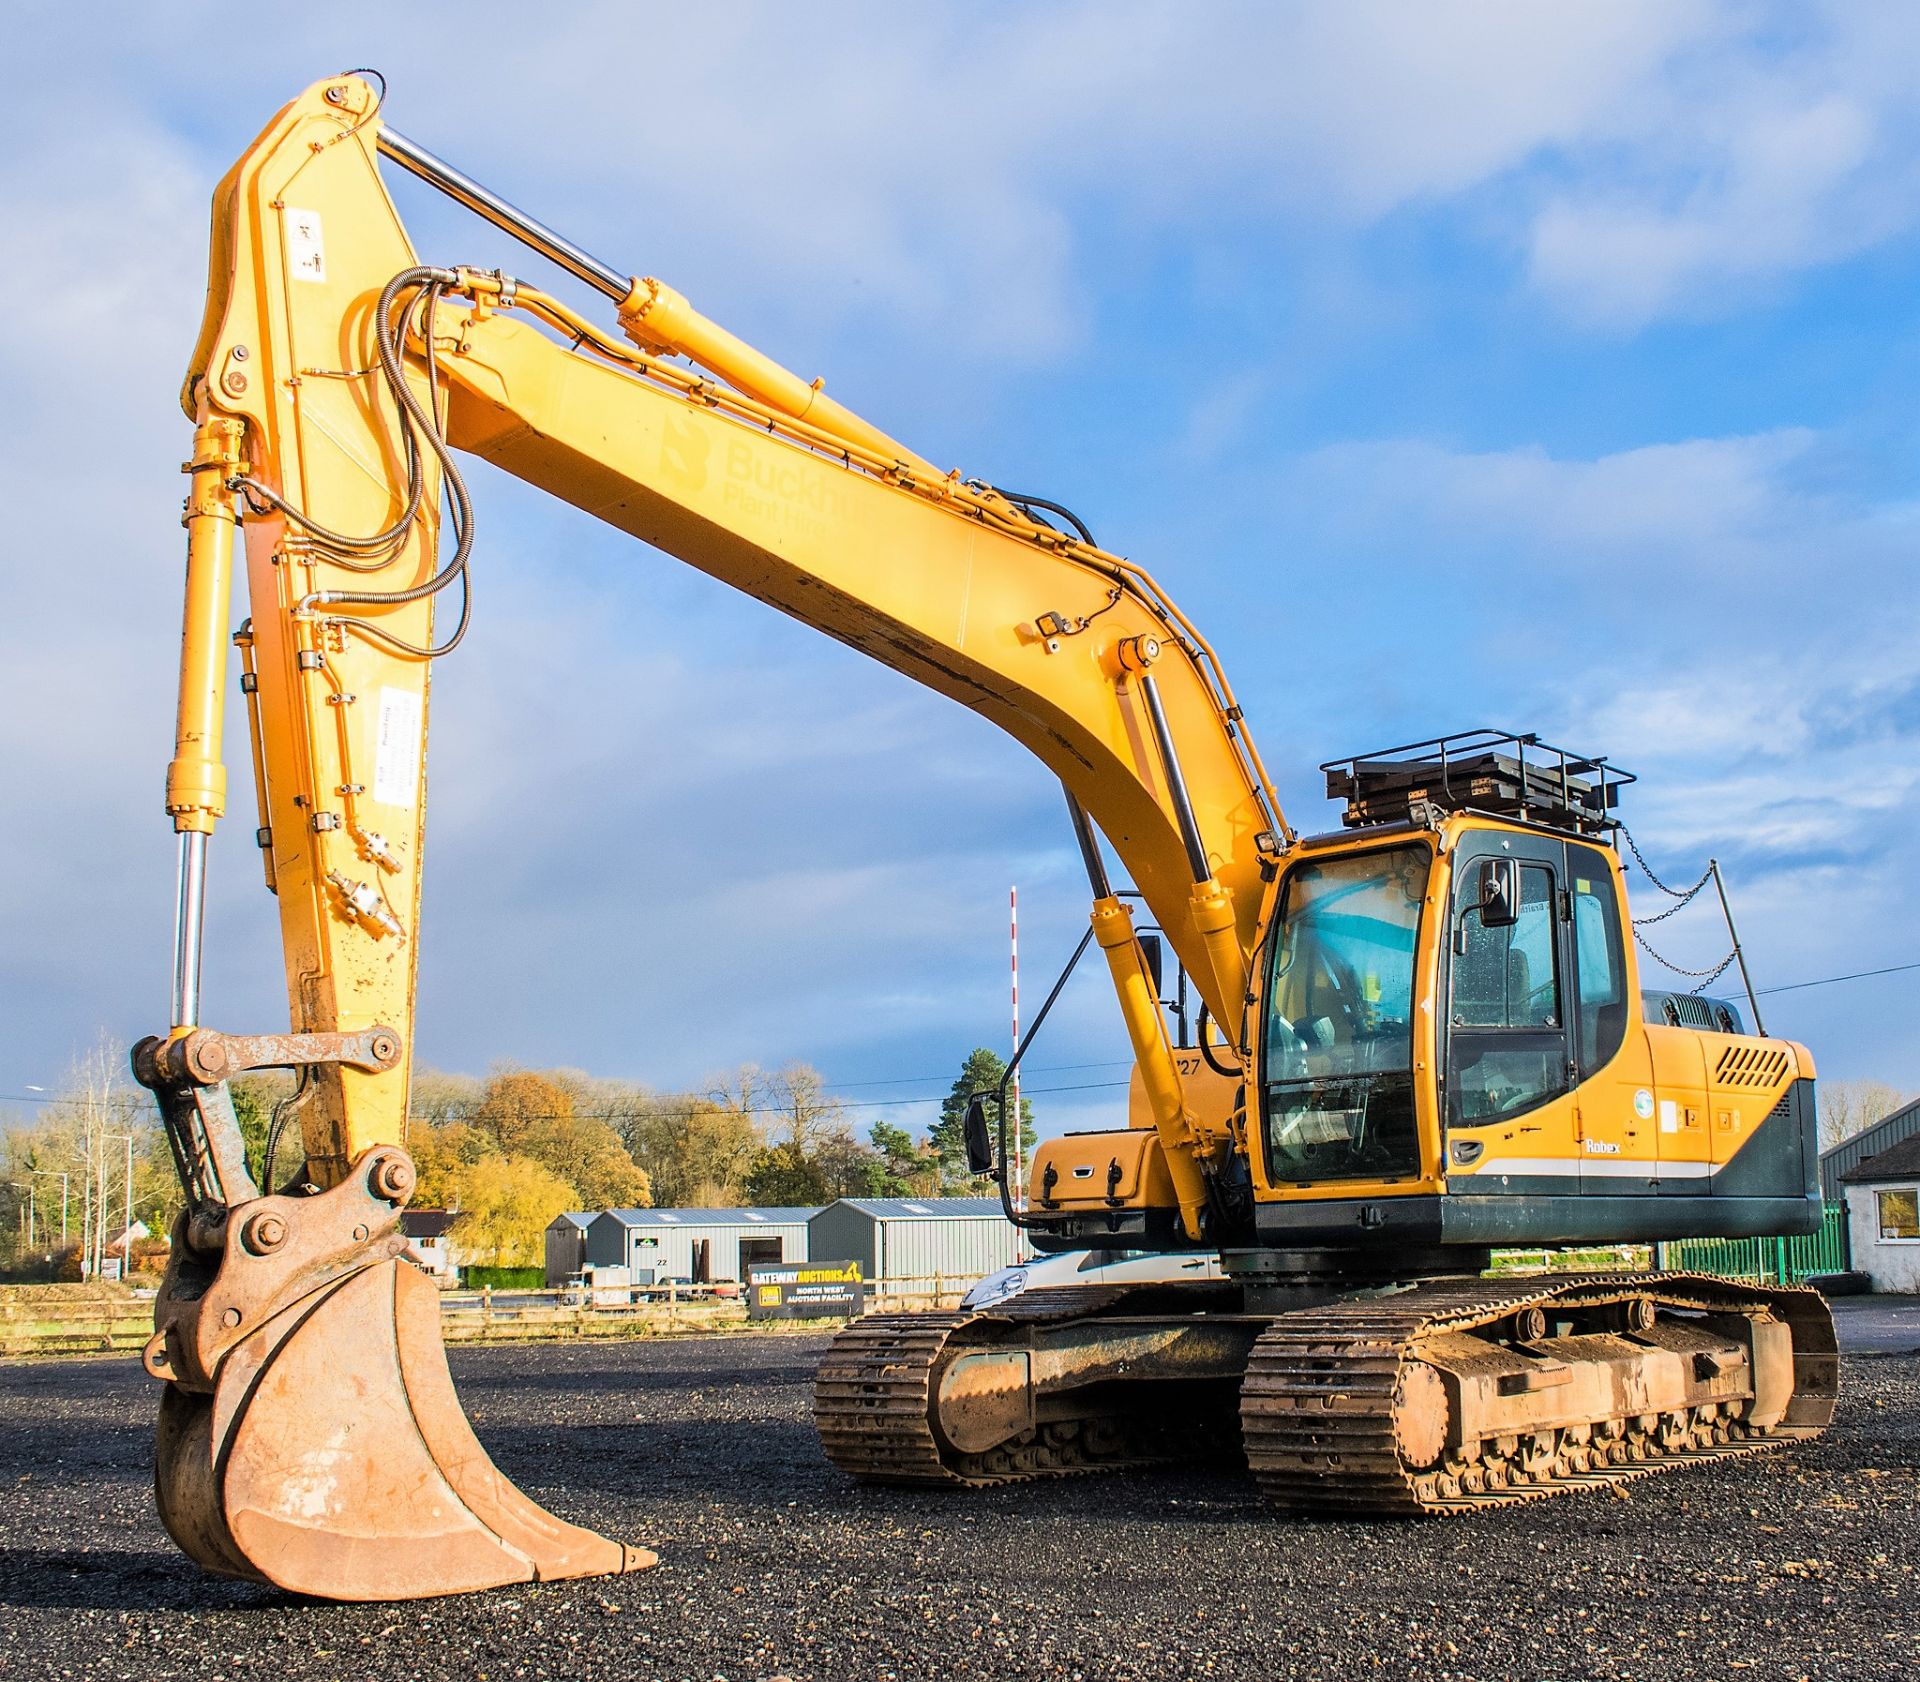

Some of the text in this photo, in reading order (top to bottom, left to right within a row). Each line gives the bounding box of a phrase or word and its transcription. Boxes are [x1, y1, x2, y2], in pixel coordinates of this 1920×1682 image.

[1585, 1138, 1621, 1154] Robex
[796, 1286, 845, 1295] NORTH WEST
[786, 1295, 820, 1303] AUCTION
[821, 1293, 855, 1302] FACILITY
